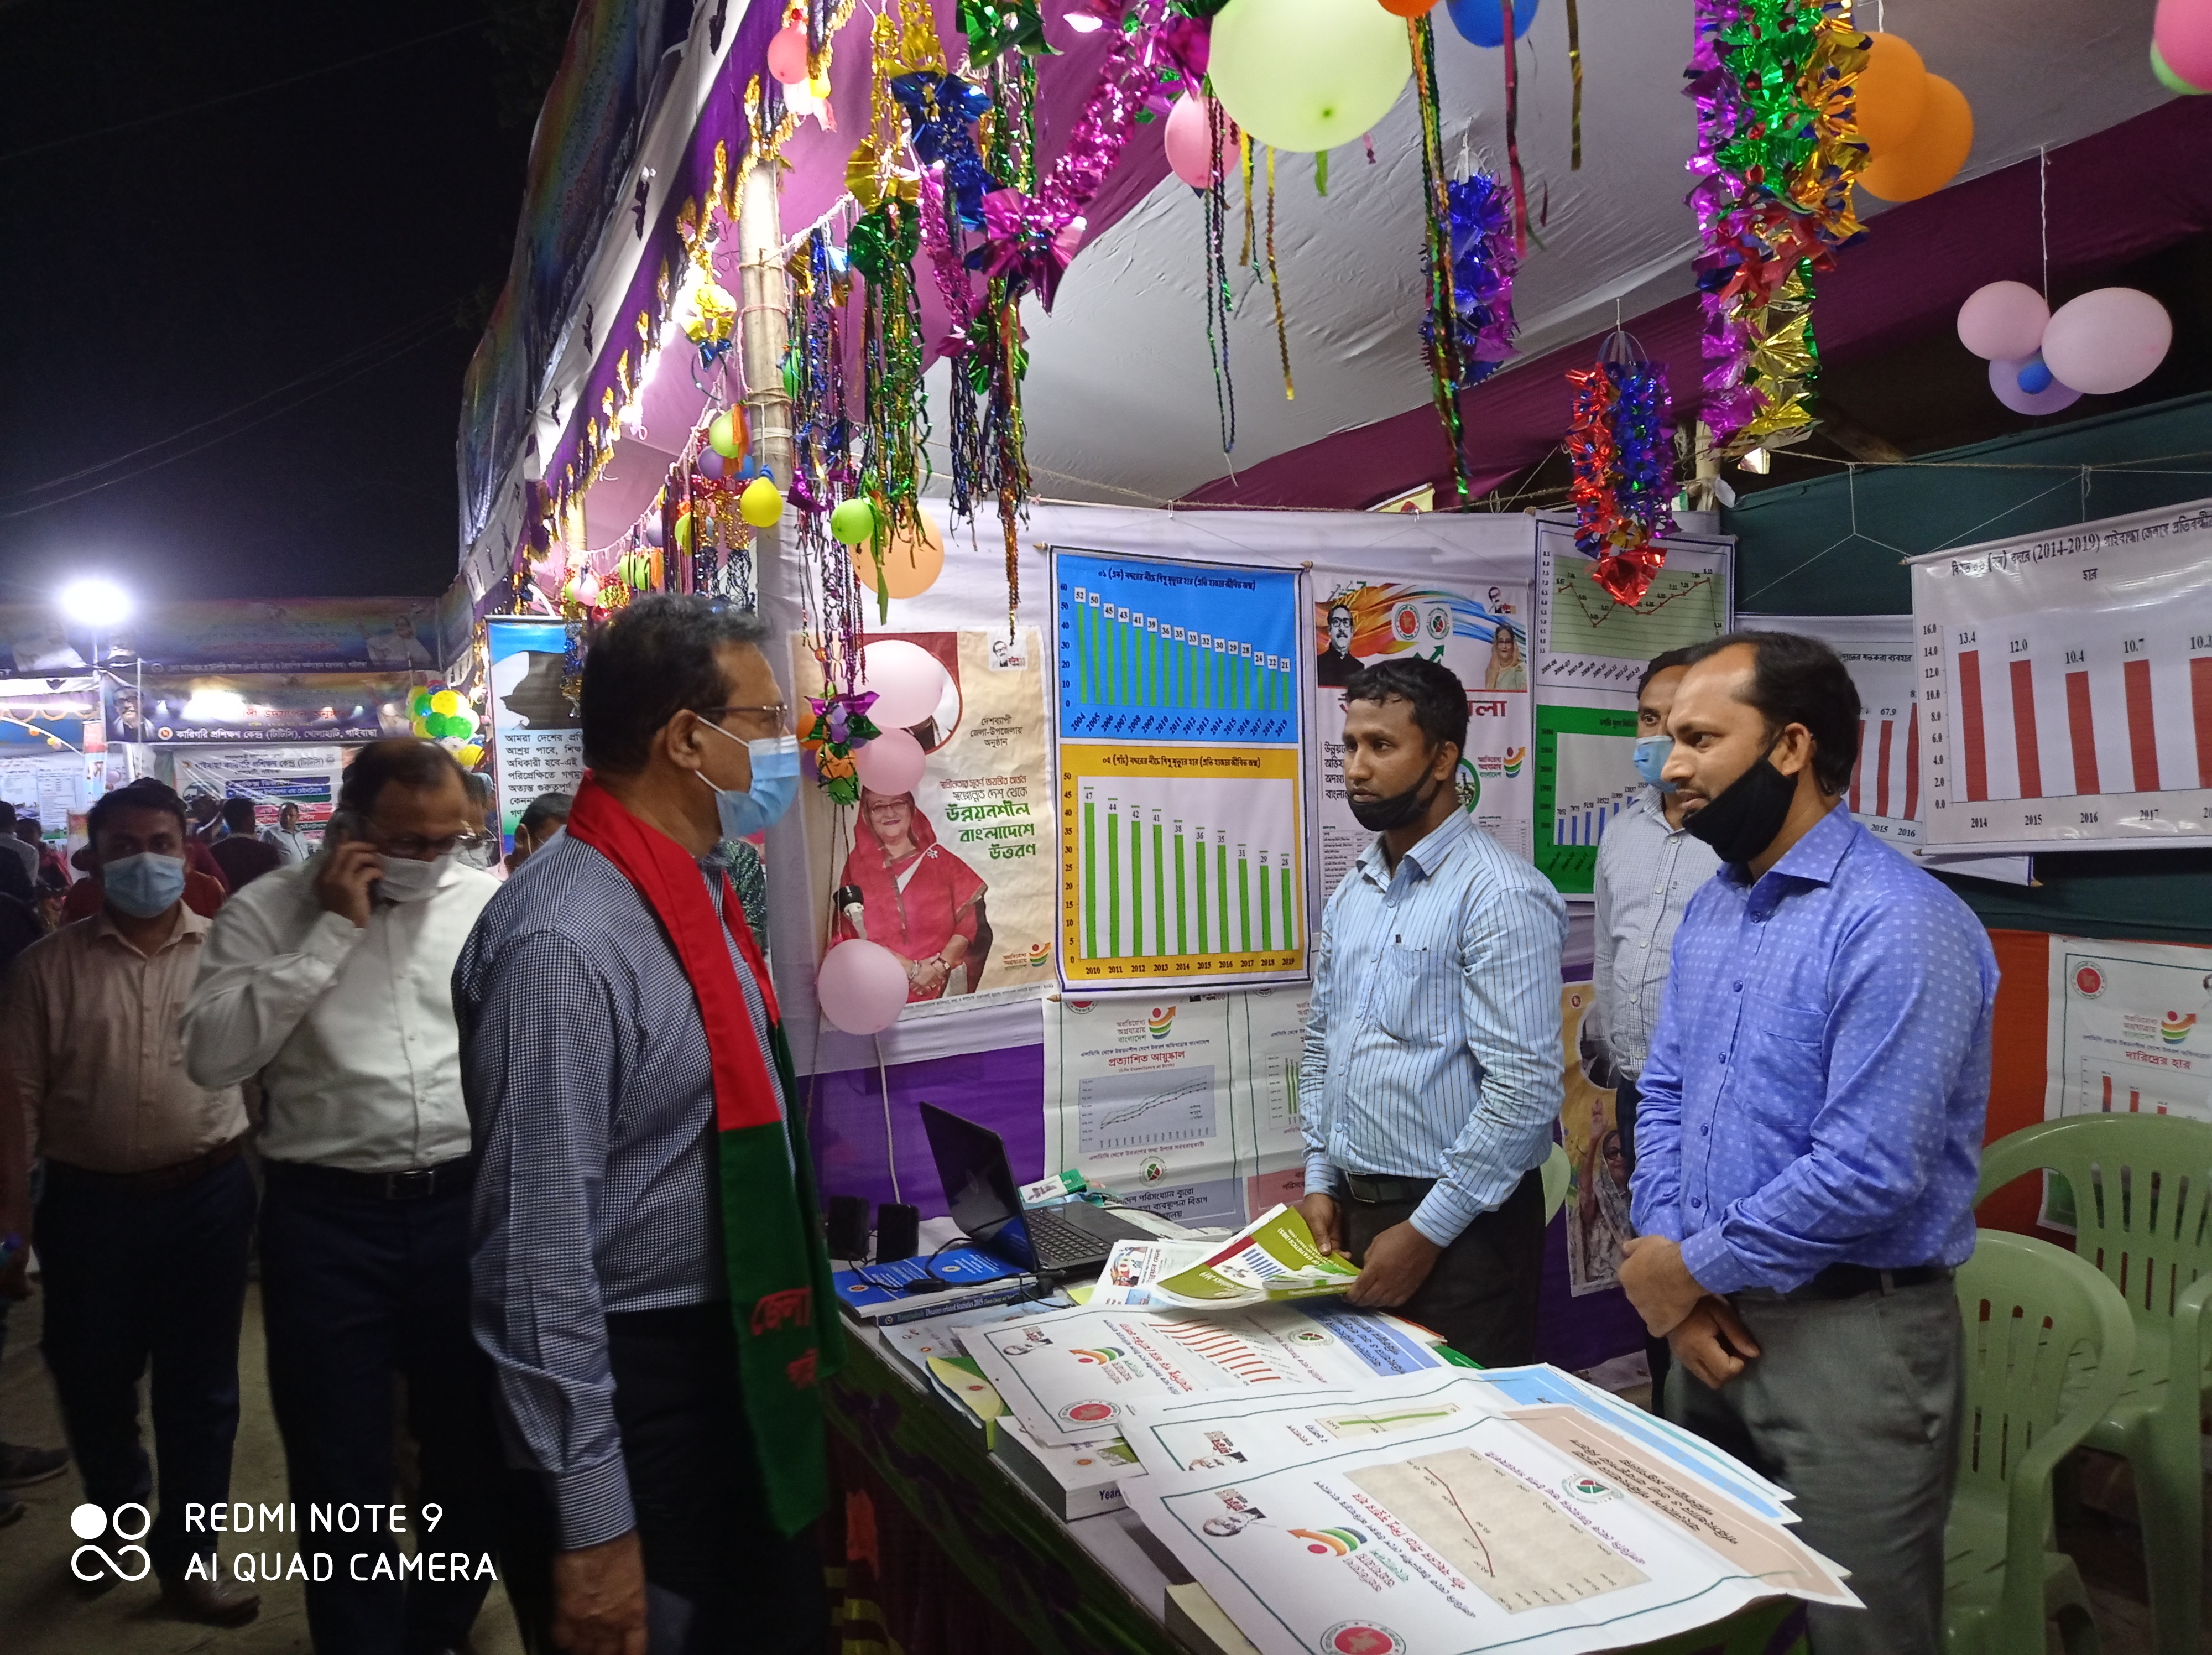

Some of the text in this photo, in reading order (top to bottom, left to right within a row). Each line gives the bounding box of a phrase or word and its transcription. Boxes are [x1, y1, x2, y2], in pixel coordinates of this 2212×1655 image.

[1923, 624, 1936, 635] 16.0
[1959, 632, 1975, 644] 13.4
[2011, 639, 2027, 653] 12.0
[2124, 638, 2144, 653] 10.7
[1924, 646, 1938, 657] 14.0
[2066, 650, 2084, 664] 10.4
[1926, 668, 1939, 678] 12.0
[1927, 690, 1940, 700] 10.0
[981, 714, 1011, 726] দেশব্যাপী
[1931, 711, 1941, 721] 8.0
[176, 728, 208, 739] কারিগরি
[211, 728, 240, 739] প্রশিক্ষণ
[243, 729, 263, 739] কেন্দ্র
[266, 728, 301, 740] (টিটিসি),
[345, 727, 378, 738] গাইবান্ধা
[971, 726, 1022, 737] জেলা-উপজেলায়
[984, 738, 1008, 748] অনুষ্ঠান
[1932, 733, 1942, 743] 6.0
[507, 757, 577, 767] অধিকারী হবে-এই
[1933, 755, 1943, 765] 4.0
[508, 770, 555, 779] পরিপ্রেক্ষিতে
[1324, 774, 1344, 783] অদম্য
[970, 777, 984, 788] সুবর্ণ
[1009, 774, 1026, 784] অর্জন
[1935, 777, 1944, 787] 2.0
[953, 787, 1027, 802] স্বল্পোন্নত দেশ থেকে
[1936, 799, 1945, 809] 0.0
[945, 801, 1031, 823] উন্নয়নশীল
[1971, 809, 2159, 828] 2014 2015 2016 2017
[959, 823, 1035, 842] বাংলাদেশে
[1871, 824, 1916, 837] 2015 2016
[988, 844, 1036, 860] উত্তরণ
[1118, 1034, 1146, 1043] বাংলাদেশ
[1109, 1050, 1186, 1067] প্রত্যাশিত আয়ুষ্কাল
[2172, 1058, 2191, 1069] হার
[1139, 1188, 1194, 1203] পরিসংখ্যান ব্যুরো
[1153, 1196, 1208, 1210] ব্যবস্থাপনা বিভাগ
